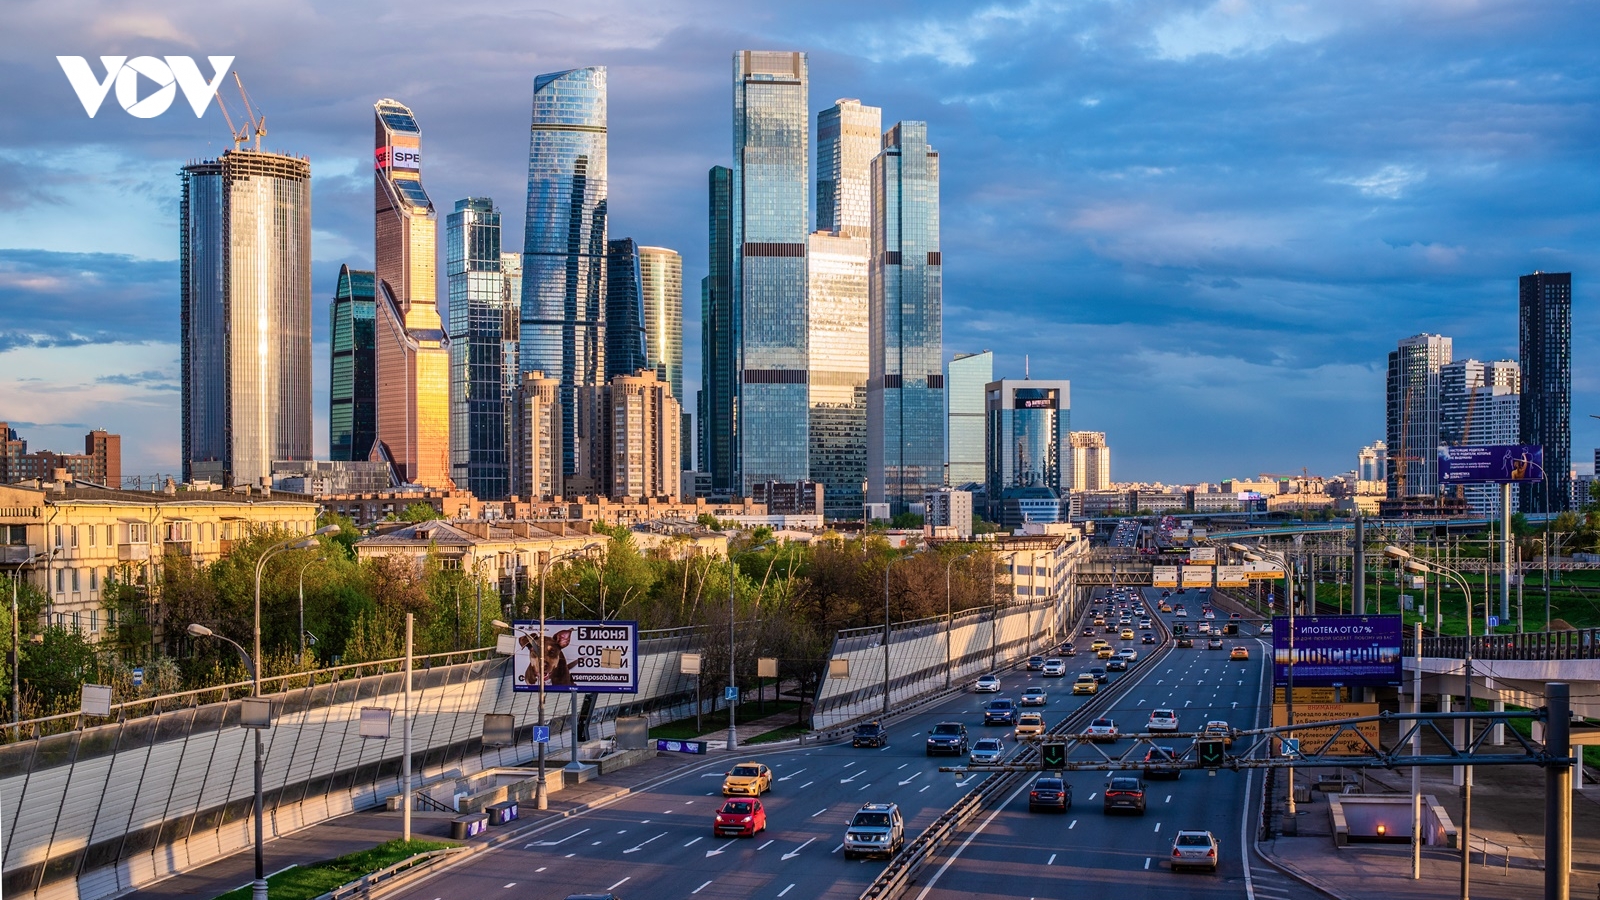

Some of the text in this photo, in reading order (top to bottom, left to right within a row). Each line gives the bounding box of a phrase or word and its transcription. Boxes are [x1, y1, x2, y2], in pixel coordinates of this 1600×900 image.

[395, 152, 420, 162] SPE
[580, 628, 587, 639] 5
[578, 645, 628, 656] СОБУ
[578, 658, 628, 668] ВОЗИ
